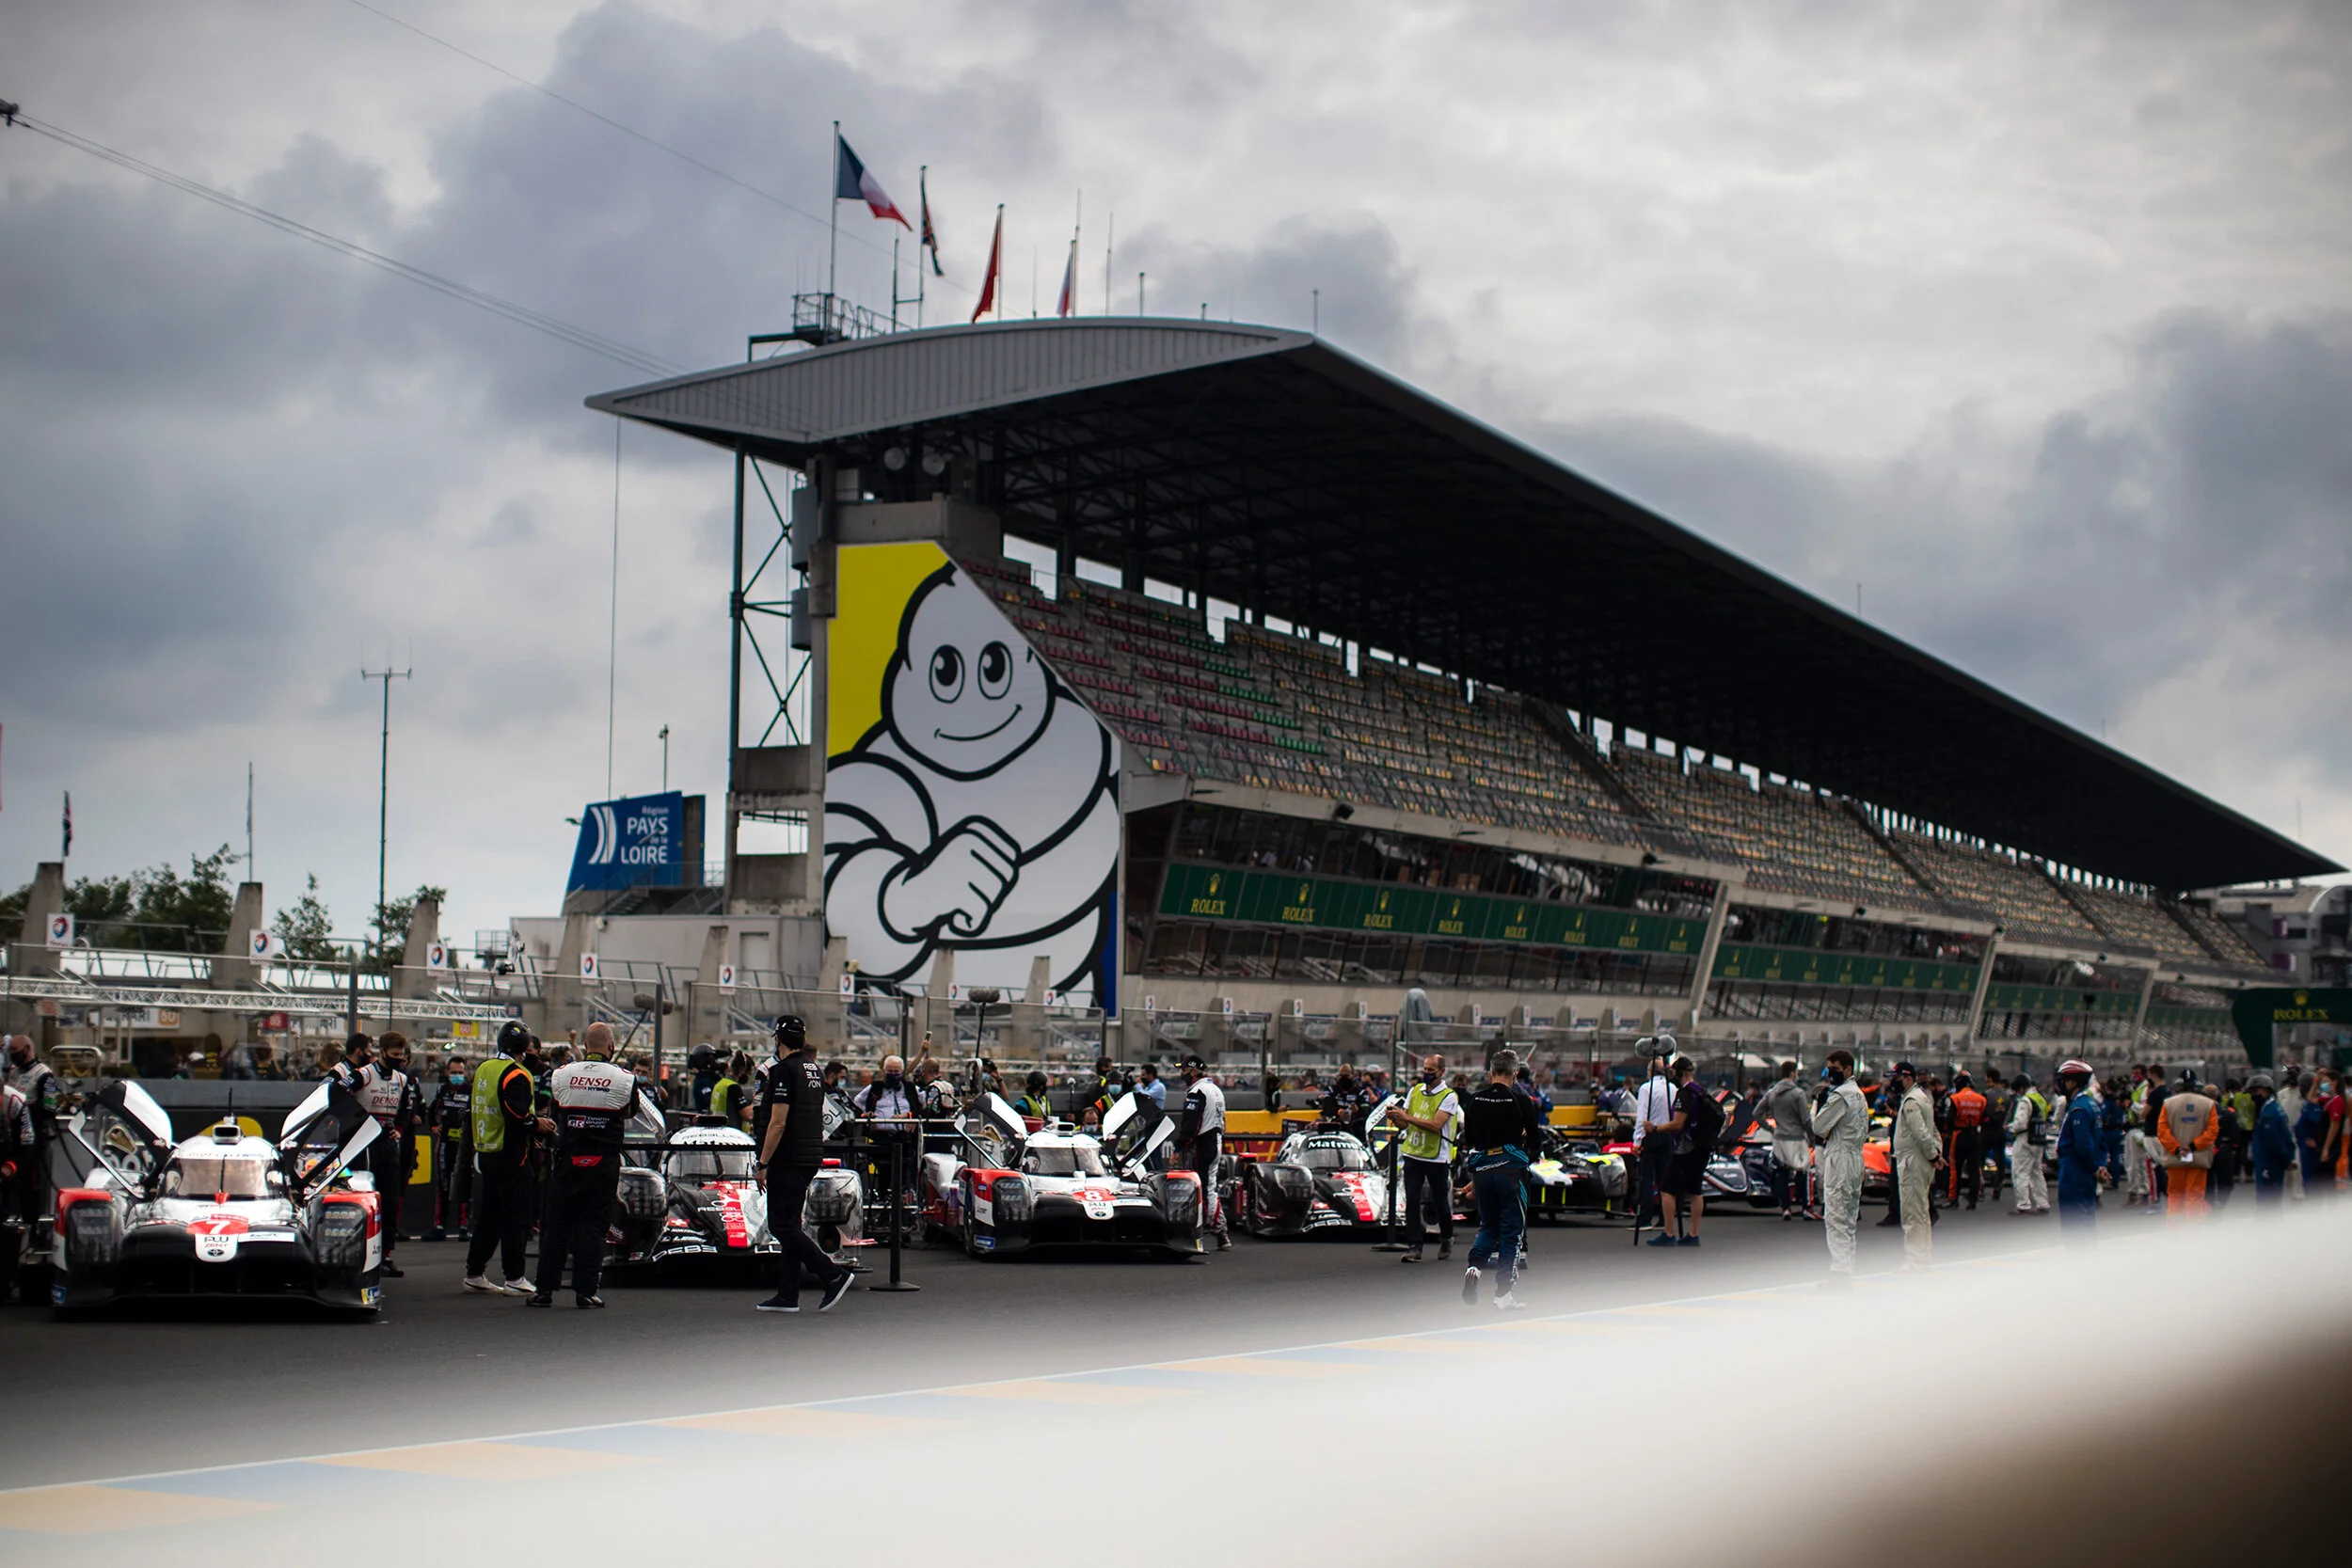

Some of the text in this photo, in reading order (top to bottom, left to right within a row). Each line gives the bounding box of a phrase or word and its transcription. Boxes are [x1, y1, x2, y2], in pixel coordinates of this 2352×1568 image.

[628, 817, 668, 835] PAYS
[650, 835, 668, 844] de la
[621, 847, 668, 864] LOIRE
[1190, 898, 1226, 915] ROLEX
[1281, 906, 1315, 922] ROLEX
[1363, 914, 1392, 928] ROLEX
[1438, 920, 1464, 934] ROLEX
[2273, 1008, 2329, 1021] ROLEX
[569, 1076, 612, 1088] DENSO
[568, 1119, 584, 1128] GR
[1086, 1190, 1104, 1201] 8
[205, 1221, 230, 1235] 7
